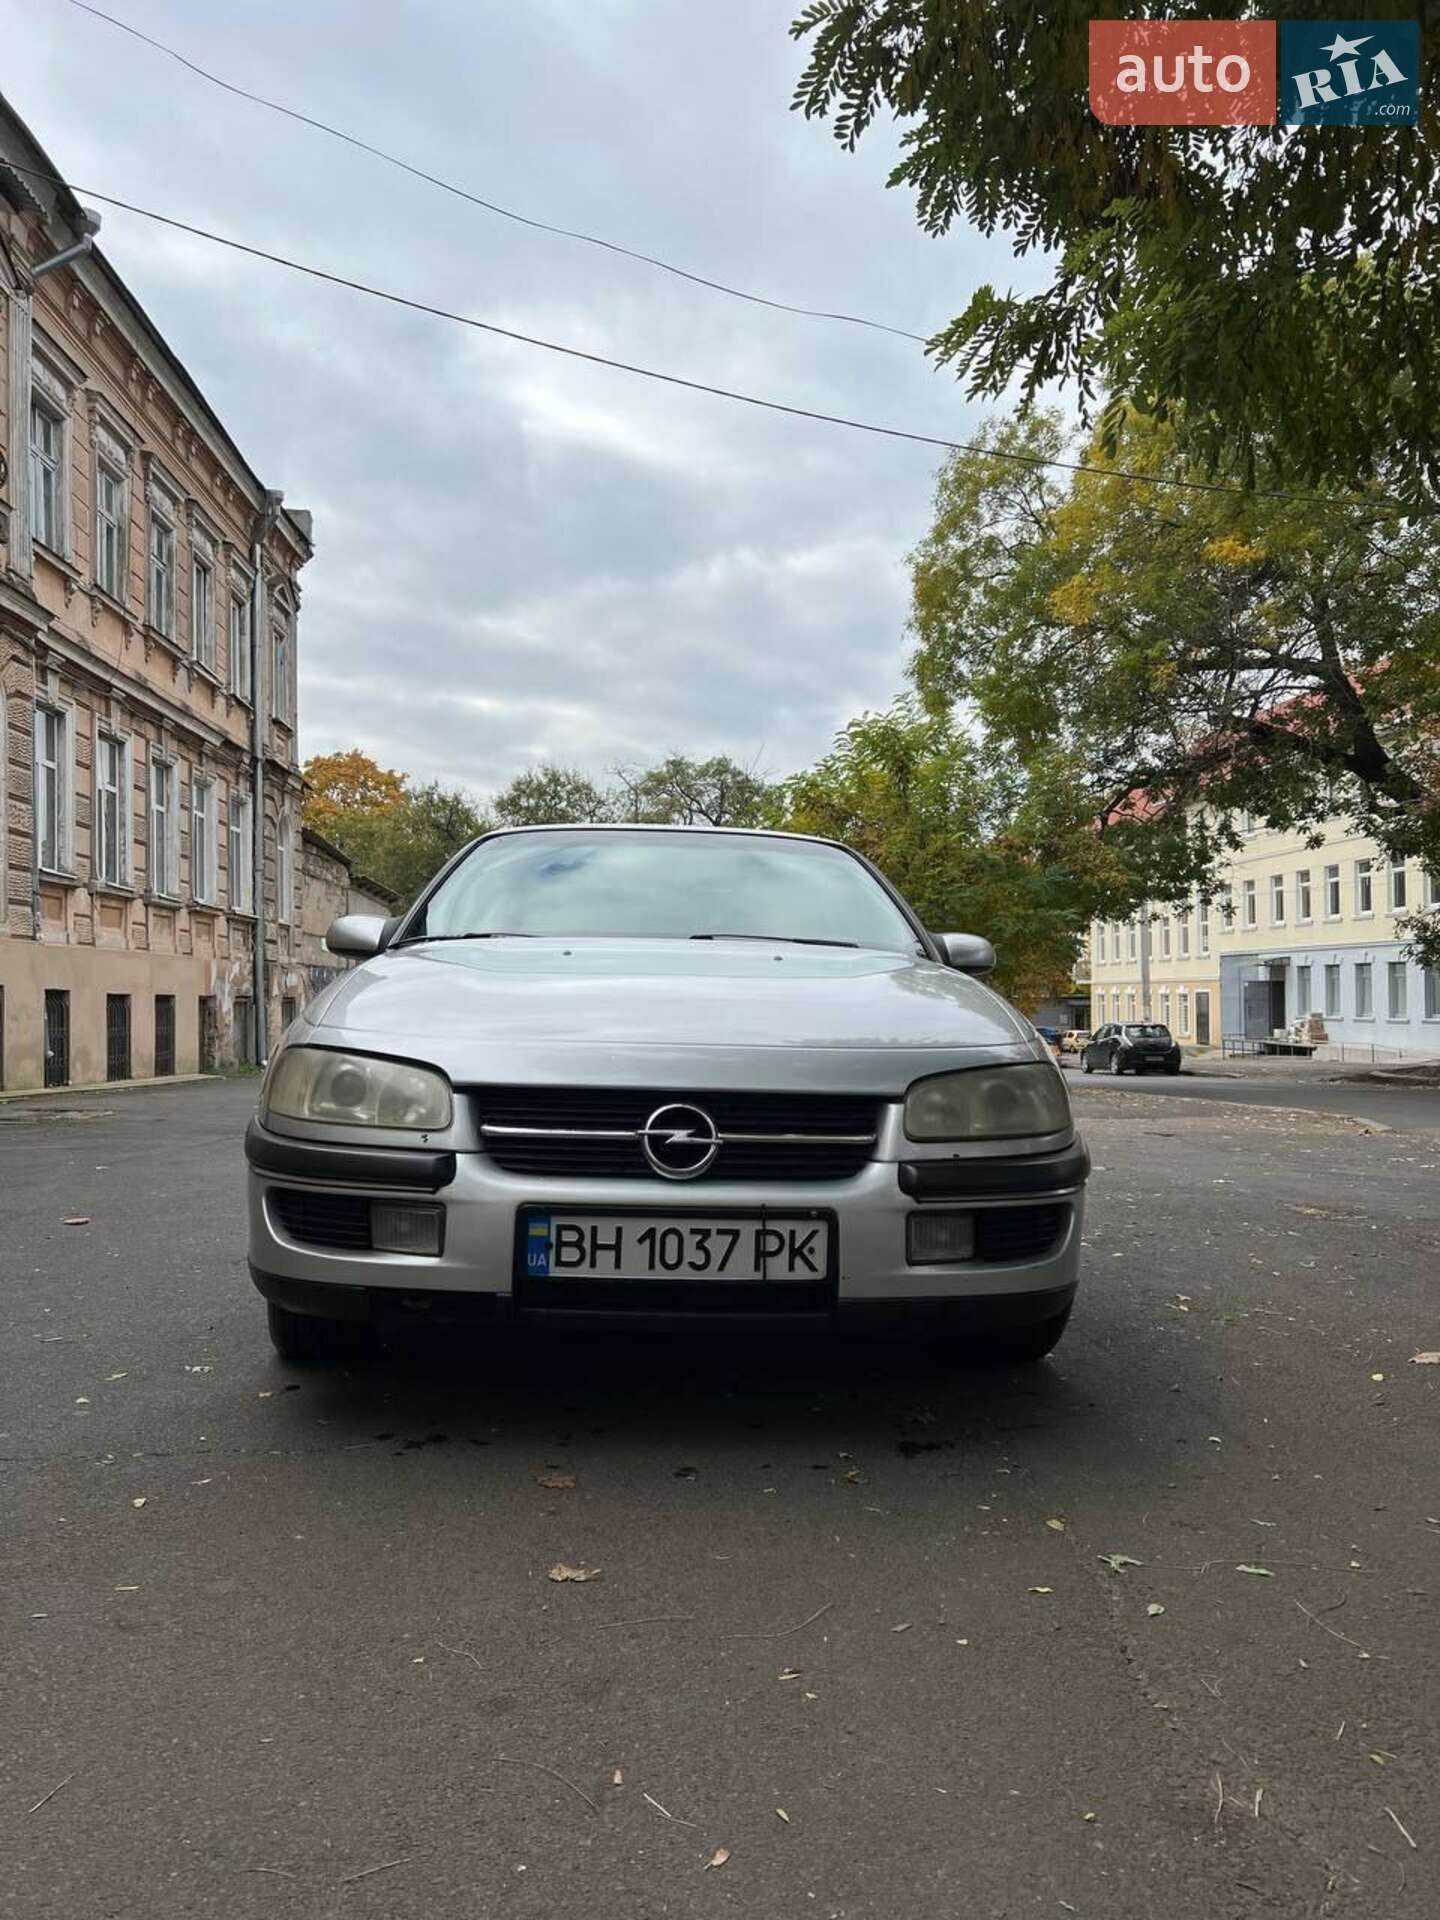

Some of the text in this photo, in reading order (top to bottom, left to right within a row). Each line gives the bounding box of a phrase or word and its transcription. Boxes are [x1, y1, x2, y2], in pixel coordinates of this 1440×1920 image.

[527, 1253, 546, 1267] UA
[554, 1224, 820, 1273] BH 1037 PK
